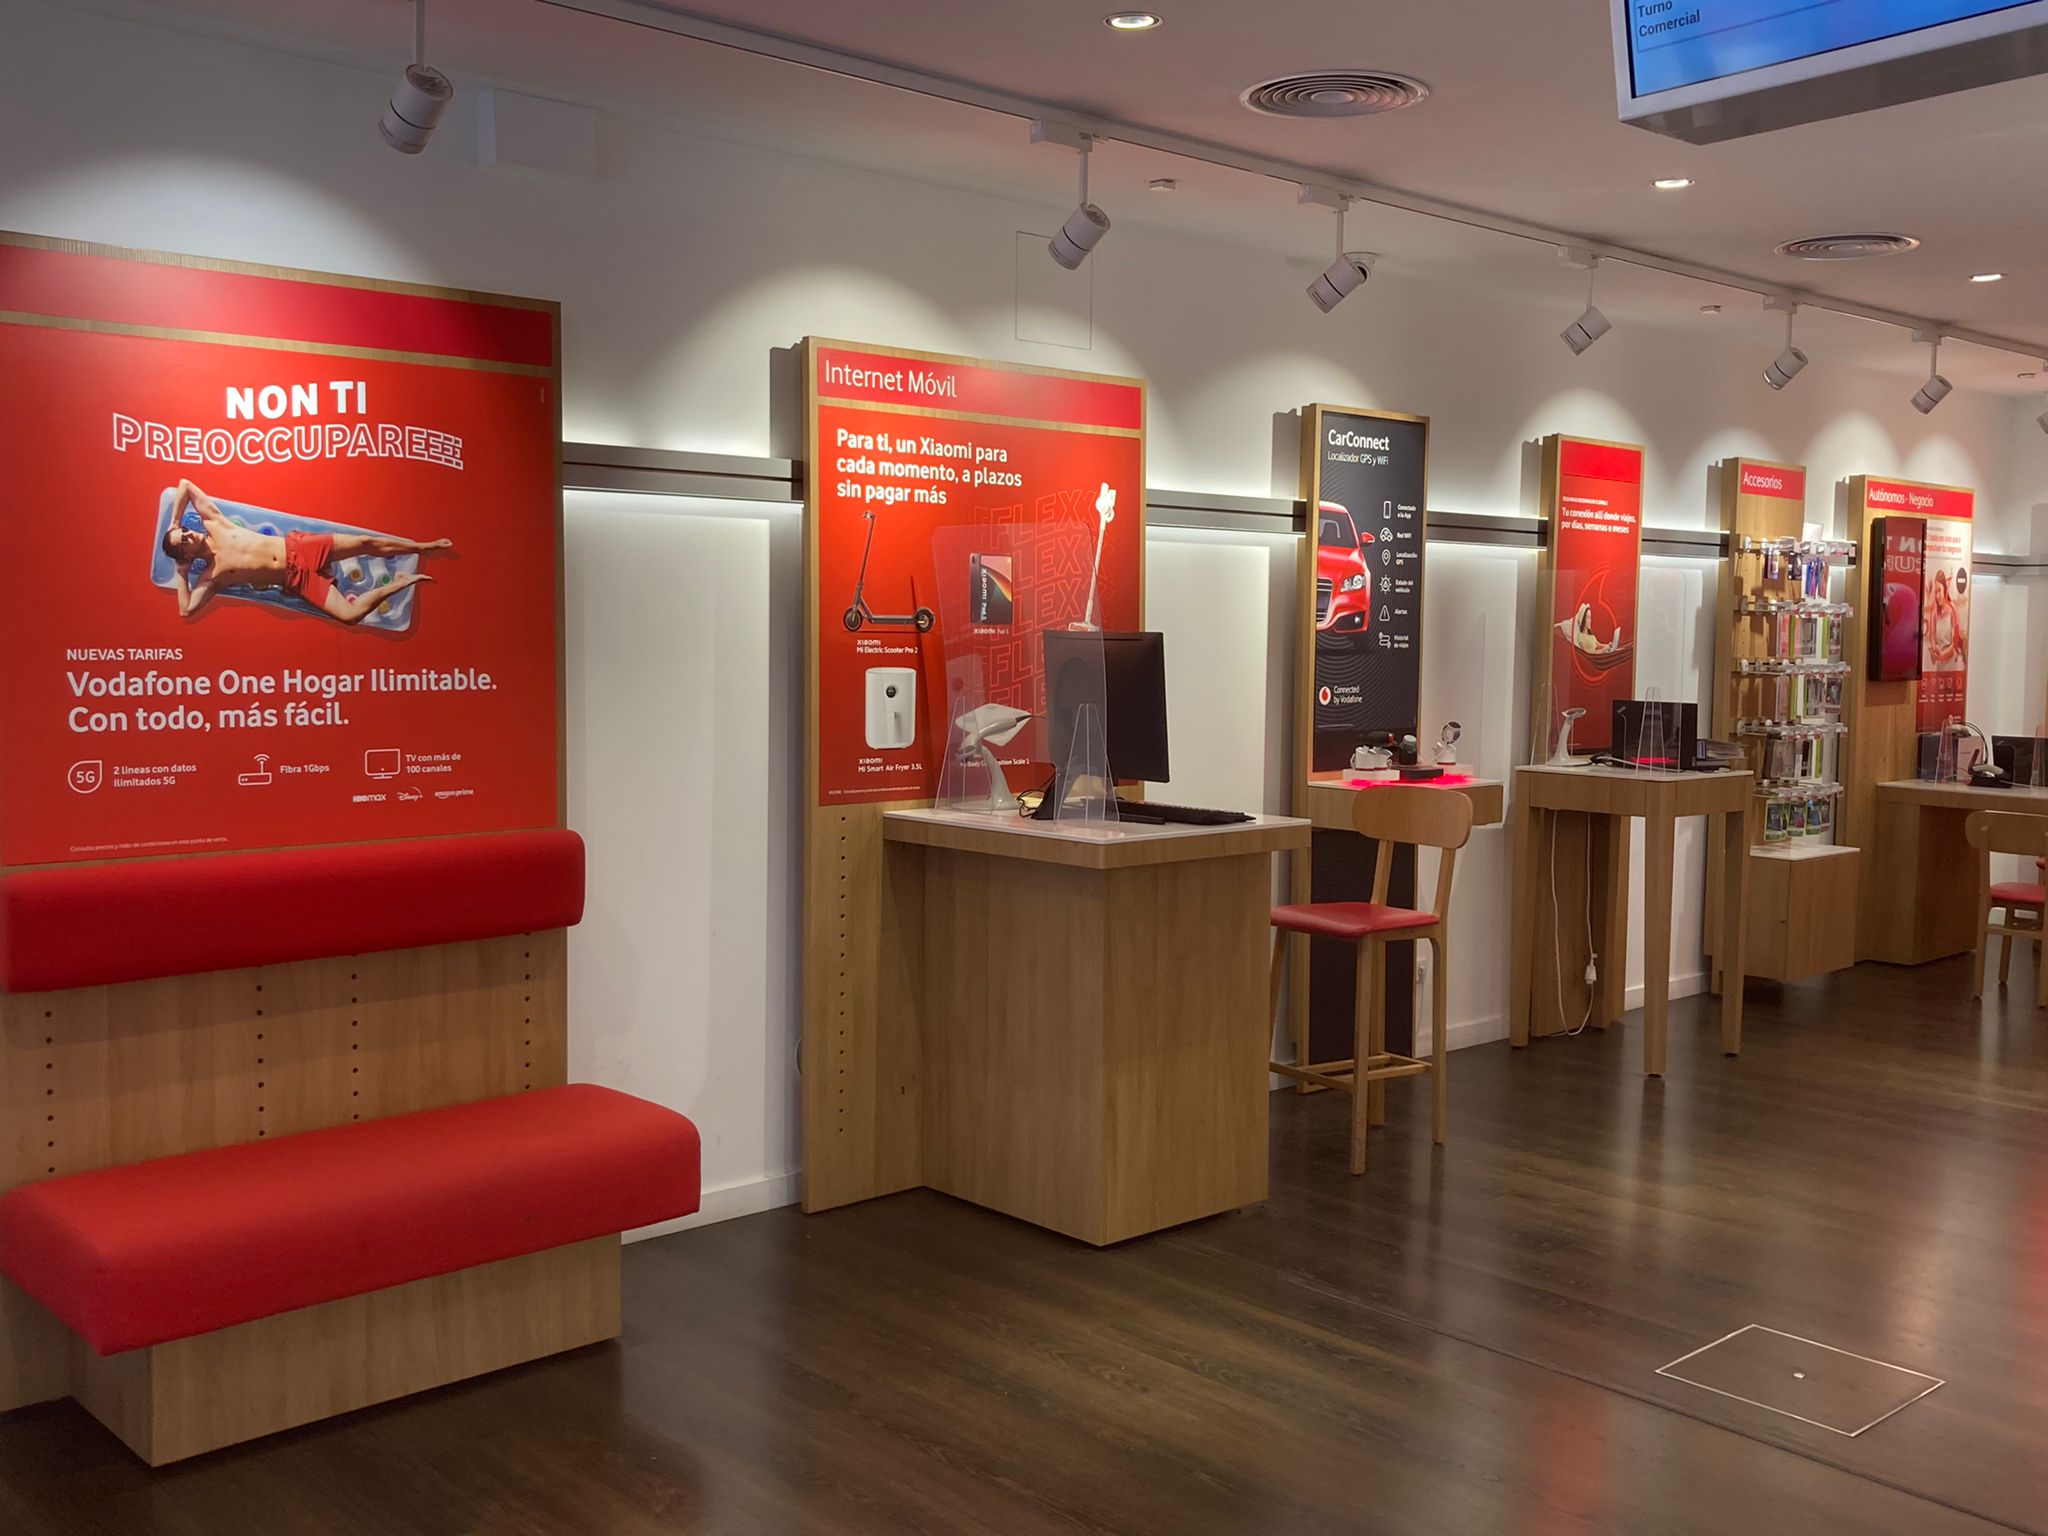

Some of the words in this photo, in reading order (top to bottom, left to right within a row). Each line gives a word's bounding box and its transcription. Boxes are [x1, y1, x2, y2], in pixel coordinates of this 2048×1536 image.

[1637, 0, 1673, 18] Turno
[1639, 9, 1700, 37] Comercial
[825, 360, 903, 392] Internet
[908, 371, 957, 398] Móvil
[226, 383, 318, 420] NON
[330, 380, 367, 415] TI
[837, 428, 873, 450] Para
[877, 432, 893, 454] ti,
[896, 437, 916, 453] un
[920, 436, 972, 460] Xiaomi
[976, 446, 1008, 464] para
[1328, 429, 1390, 451] CarConnect
[1327, 451, 1359, 463] Localizador
[1360, 454, 1372, 465] GPS
[1372, 457, 1377, 466] y
[837, 455, 875, 475] cada
[879, 461, 959, 484] momento,
[962, 470, 971, 483] a
[974, 467, 1022, 487] plazos
[1743, 471, 1783, 490] Accesorios
[837, 481, 861, 498] sin
[865, 485, 911, 505] pagar
[914, 483, 947, 504] más
[1868, 487, 1905, 505] Autónomos
[1909, 491, 1934, 509] Negocio
[1562, 507, 1570, 517] Tu
[1570, 509, 1594, 519] conexión
[1561, 521, 1571, 530] por
[66, 648, 125, 661] NUEVAS
[128, 648, 183, 661] TARIFAS
[884, 646, 904, 654] Scooter
[66, 670, 211, 697] Vodafone
[218, 669, 276, 695] One
[283, 669, 365, 699] Hogar
[371, 667, 498, 692] Ilimitable.
[1333, 685, 1360, 694] Connected
[1333, 695, 1340, 705] by
[1341, 695, 1363, 704] Vodafone
[68, 706, 128, 733] Con
[135, 704, 211, 732] todo,
[219, 701, 278, 728] más
[284, 700, 349, 727] fácil.
[405, 754, 417, 762] TV
[434, 753, 450, 761] más
[451, 753, 462, 761] de
[113, 766, 120, 775] 2
[152, 766, 169, 774] con
[171, 764, 197, 773] datos
[280, 766, 302, 774] Fibra
[303, 764, 330, 774] 1Gbps
[406, 765, 420, 773] 100
[422, 764, 453, 773] canales
[867, 764, 884, 772] Smart
[895, 763, 910, 772] Fryer
[76, 771, 95, 784] 5G
[113, 777, 162, 787] ilimitados
[163, 777, 176, 786] 5G
